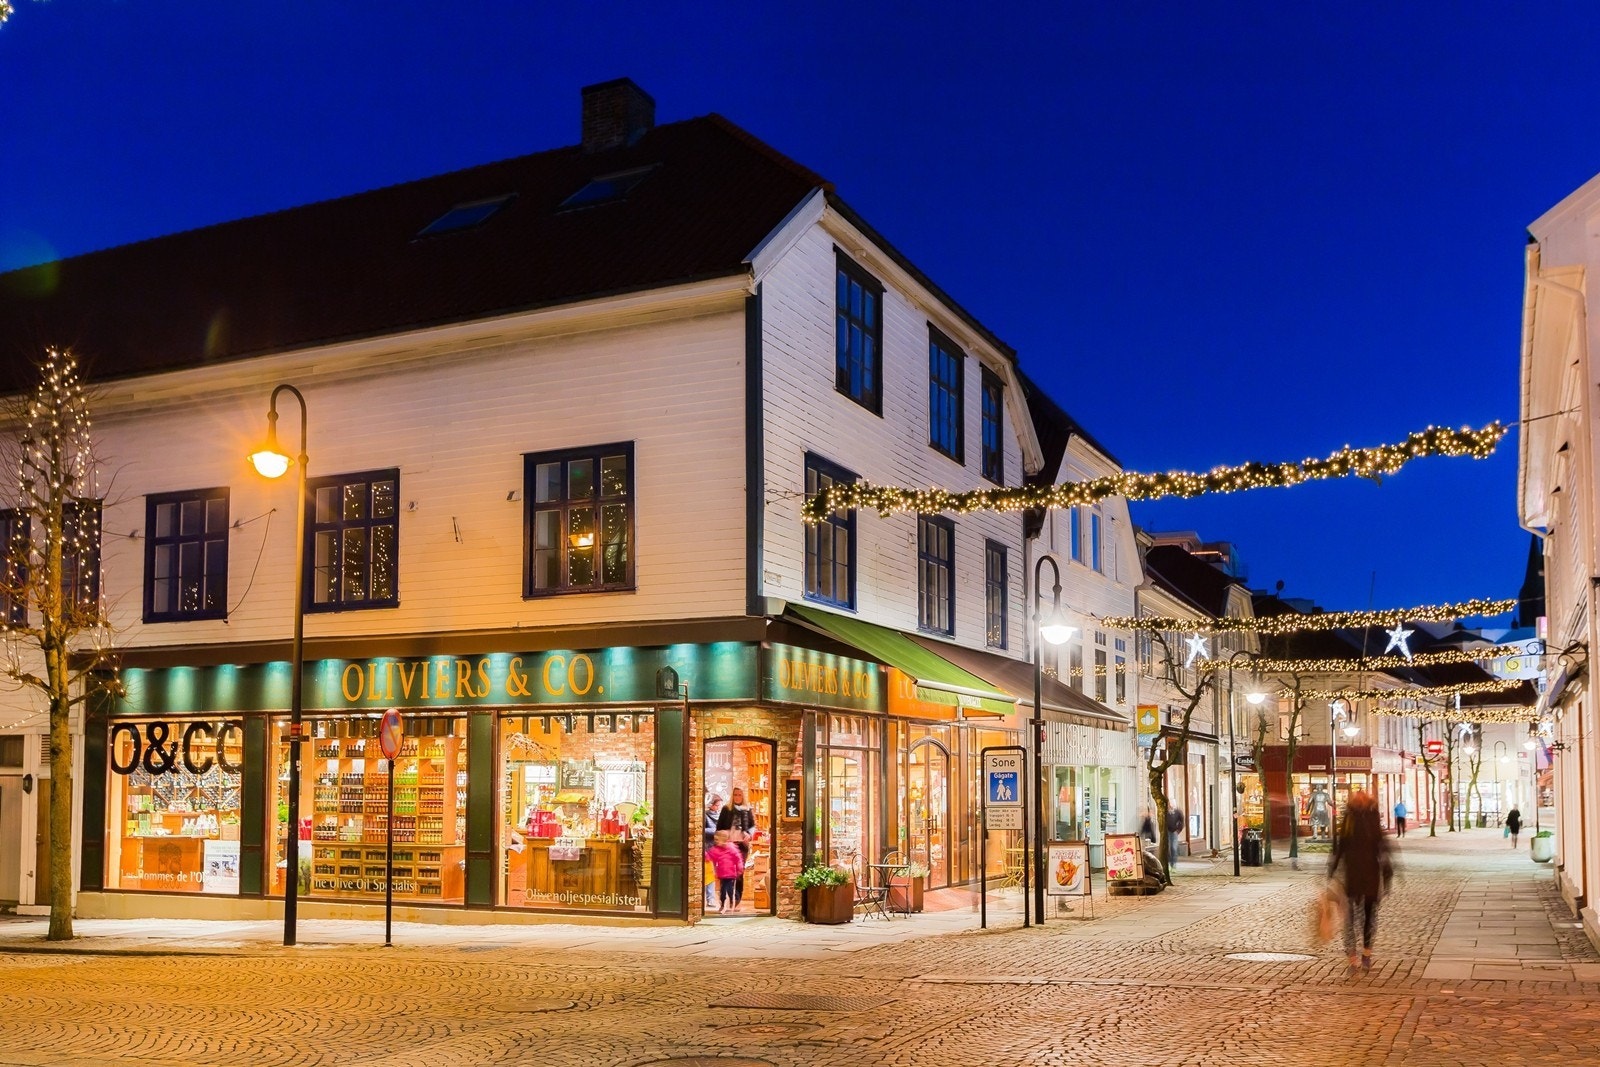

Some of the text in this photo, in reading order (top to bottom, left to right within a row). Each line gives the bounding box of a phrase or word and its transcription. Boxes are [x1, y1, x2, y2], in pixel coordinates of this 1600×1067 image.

[342, 653, 604, 702] OLIVIERS & CO.
[779, 658, 838, 695] OLIVIERS
[842, 669, 851, 697] &
[992, 757, 1015, 767] Sone
[1113, 854, 1127, 863] SALG
[177, 871, 188, 882] de
[329, 877, 353, 890] Olive
[356, 878, 370, 890] Oil
[525, 888, 642, 906] Olivenoljespesialisten
